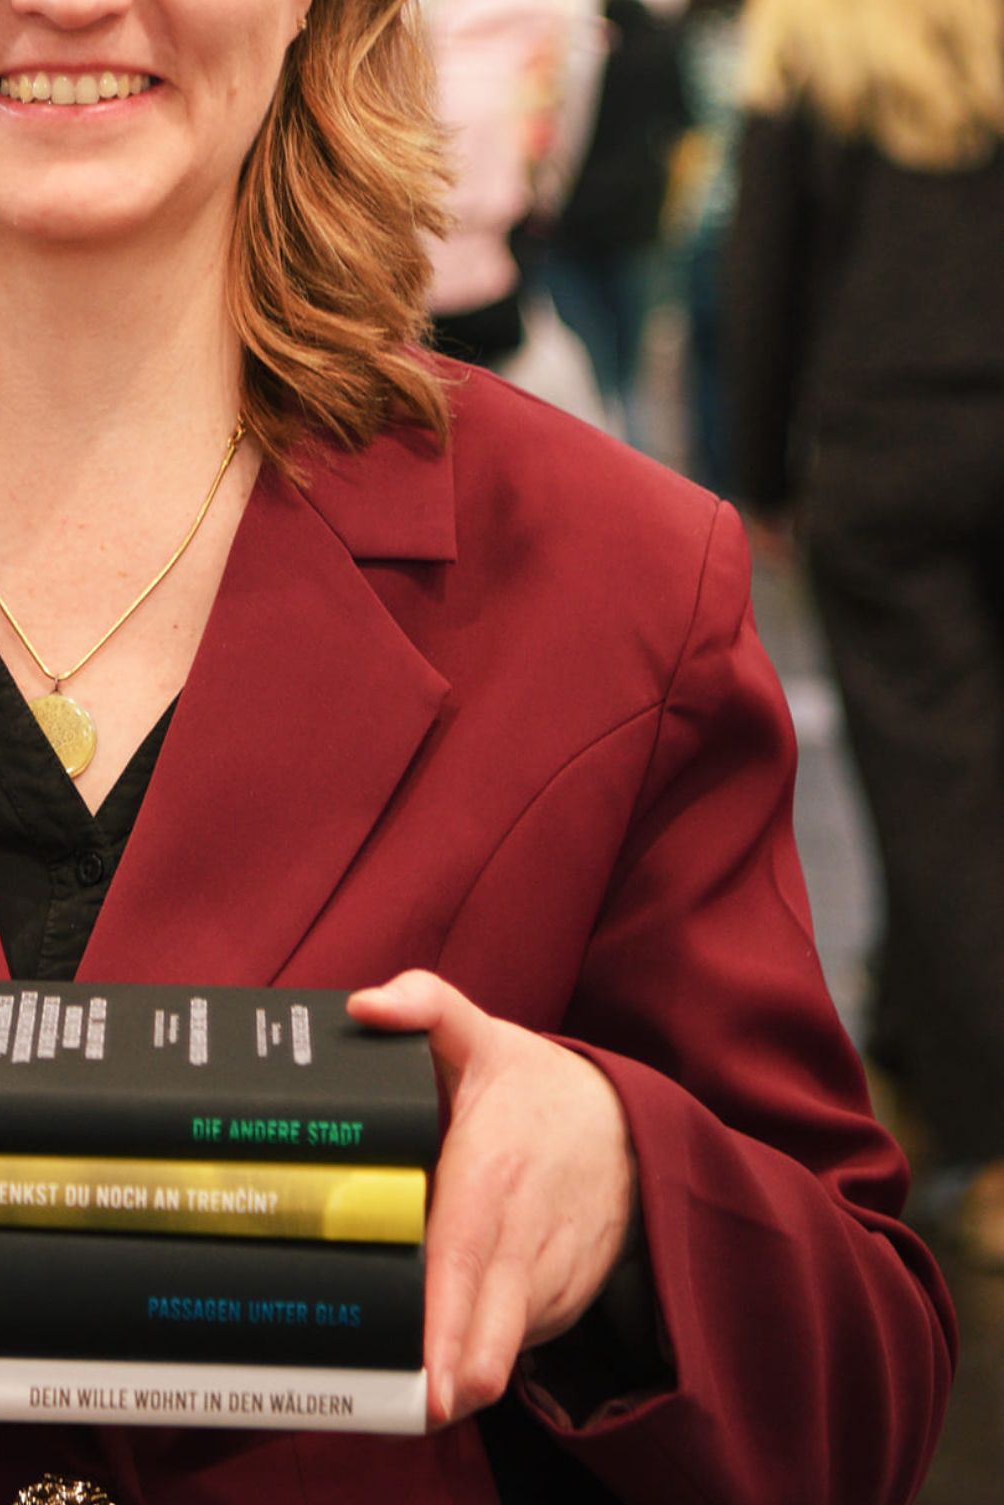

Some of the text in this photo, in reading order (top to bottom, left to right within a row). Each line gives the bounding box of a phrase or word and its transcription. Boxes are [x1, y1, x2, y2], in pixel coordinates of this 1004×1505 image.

[192, 1117, 363, 1145] DIE ANDERE STADT
[65, 1183, 90, 1207] DU
[96, 1184, 147, 1209] NOCH
[154, 1186, 179, 1211] AN
[186, 1184, 278, 1215] TRENČÍN?
[147, 1296, 362, 1327] PASSAGEN UNTER GLAS
[29, 1385, 353, 1416] DEIN WILLE WOHNT IN DEN WÄLDERN
